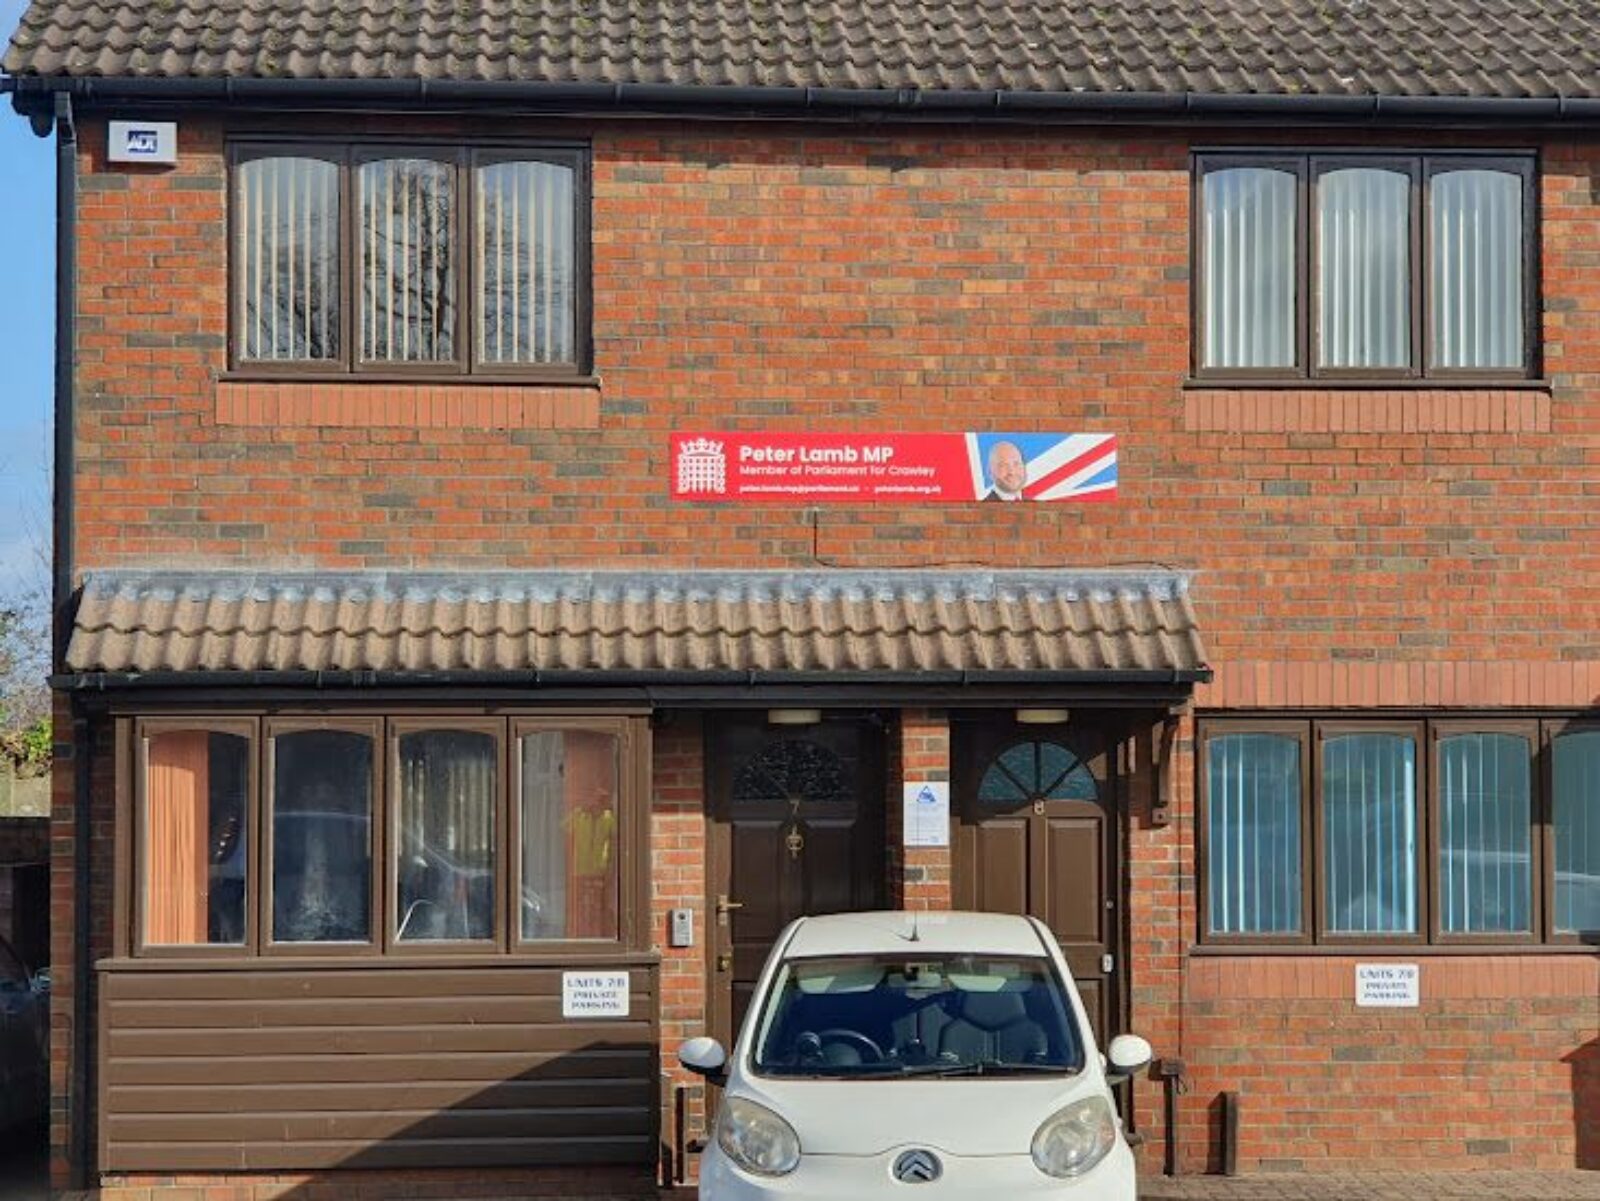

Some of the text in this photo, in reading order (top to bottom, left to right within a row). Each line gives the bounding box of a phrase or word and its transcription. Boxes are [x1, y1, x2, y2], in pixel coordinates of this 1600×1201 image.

[740, 445, 894, 463] Peter Lamb MP
[740, 465, 936, 478] Member of Parliament for Crawley
